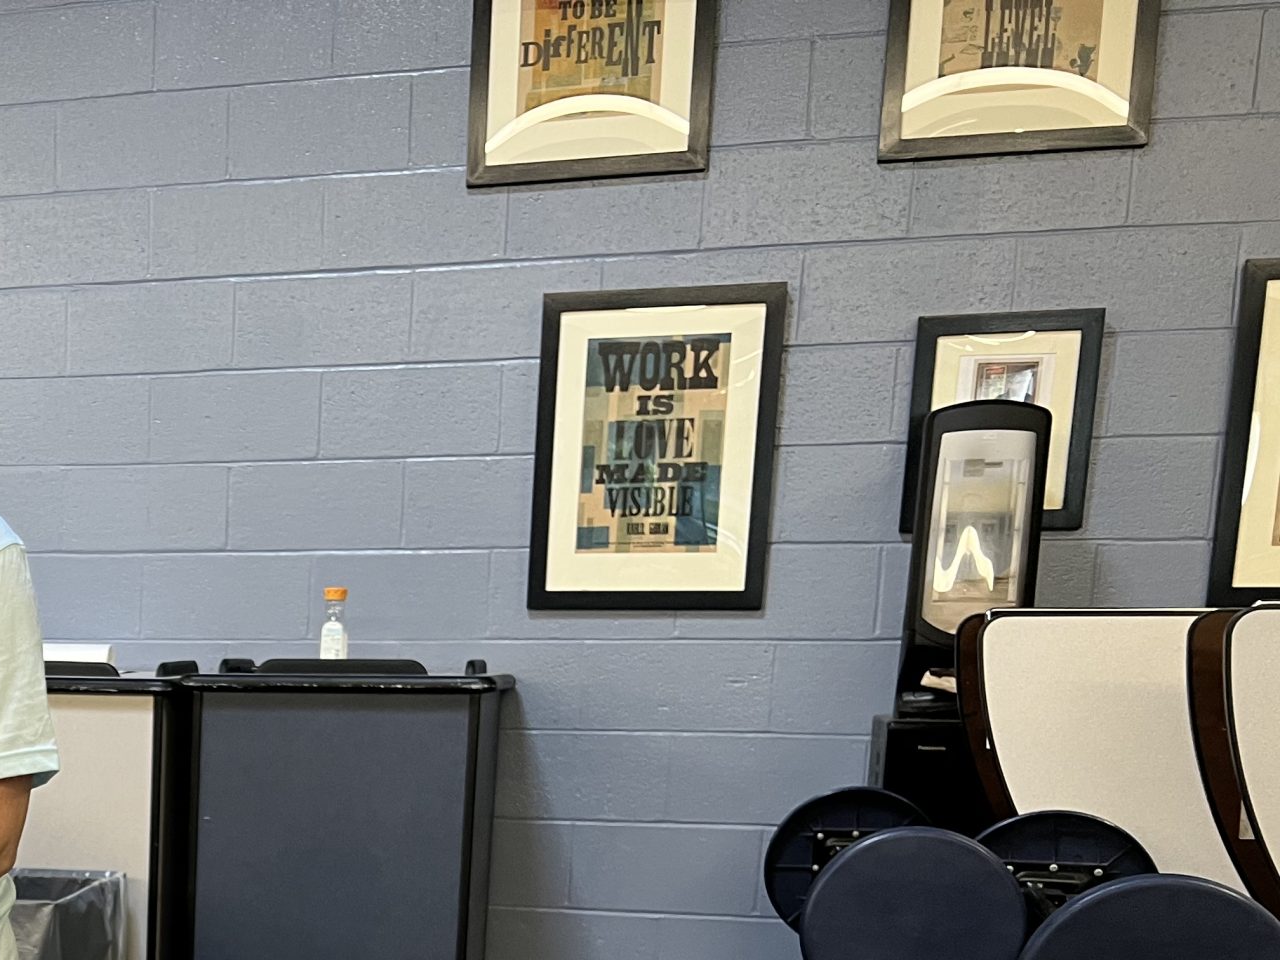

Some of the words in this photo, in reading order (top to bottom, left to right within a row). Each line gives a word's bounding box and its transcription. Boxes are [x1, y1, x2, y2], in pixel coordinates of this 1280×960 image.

[559, 0, 585, 21] TO
[590, 0, 617, 20] BE
[598, 338, 721, 393] WORK
[636, 394, 675, 416] IS
[614, 417, 696, 461] LOVE
[595, 461, 708, 485] MADE
[606, 485, 695, 518] VISIBLE
